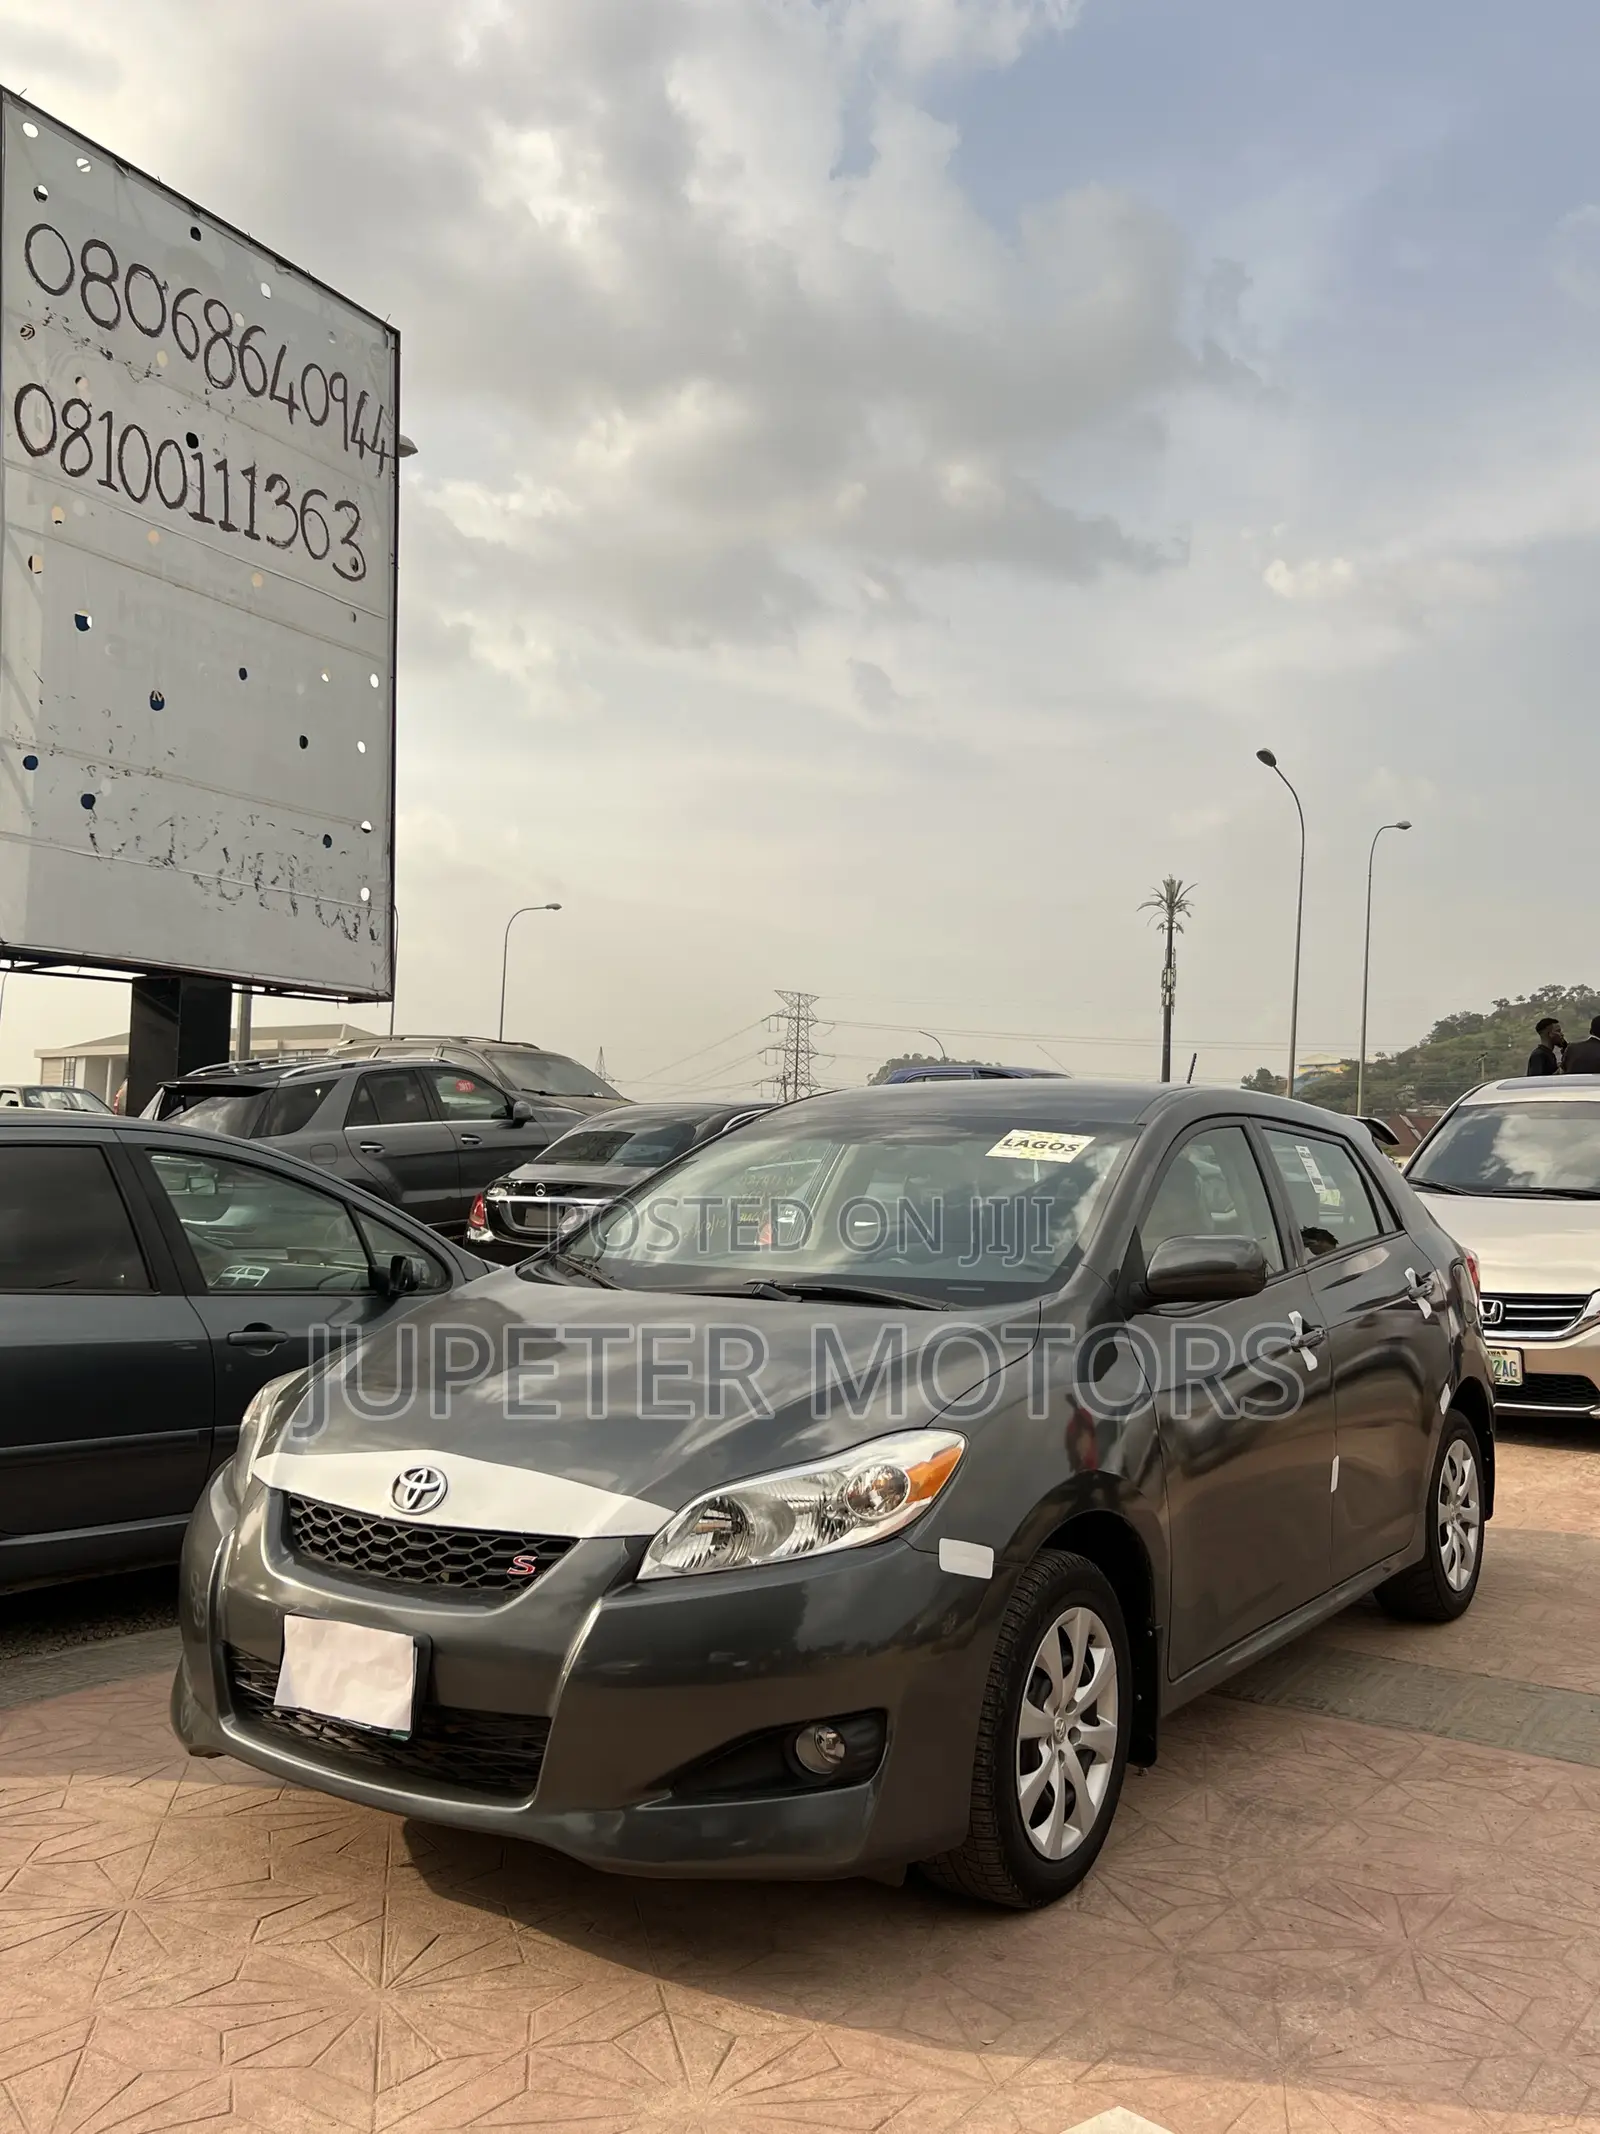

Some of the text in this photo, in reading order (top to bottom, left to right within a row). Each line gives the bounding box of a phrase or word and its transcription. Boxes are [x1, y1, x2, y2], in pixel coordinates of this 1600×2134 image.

[24, 223, 390, 476] 08068640944
[14, 383, 367, 581] 08100111363
[1002, 1138, 1080, 1152] LAGOS
[1493, 1359, 1517, 1378] 2AG
[506, 1555, 537, 1575] S
